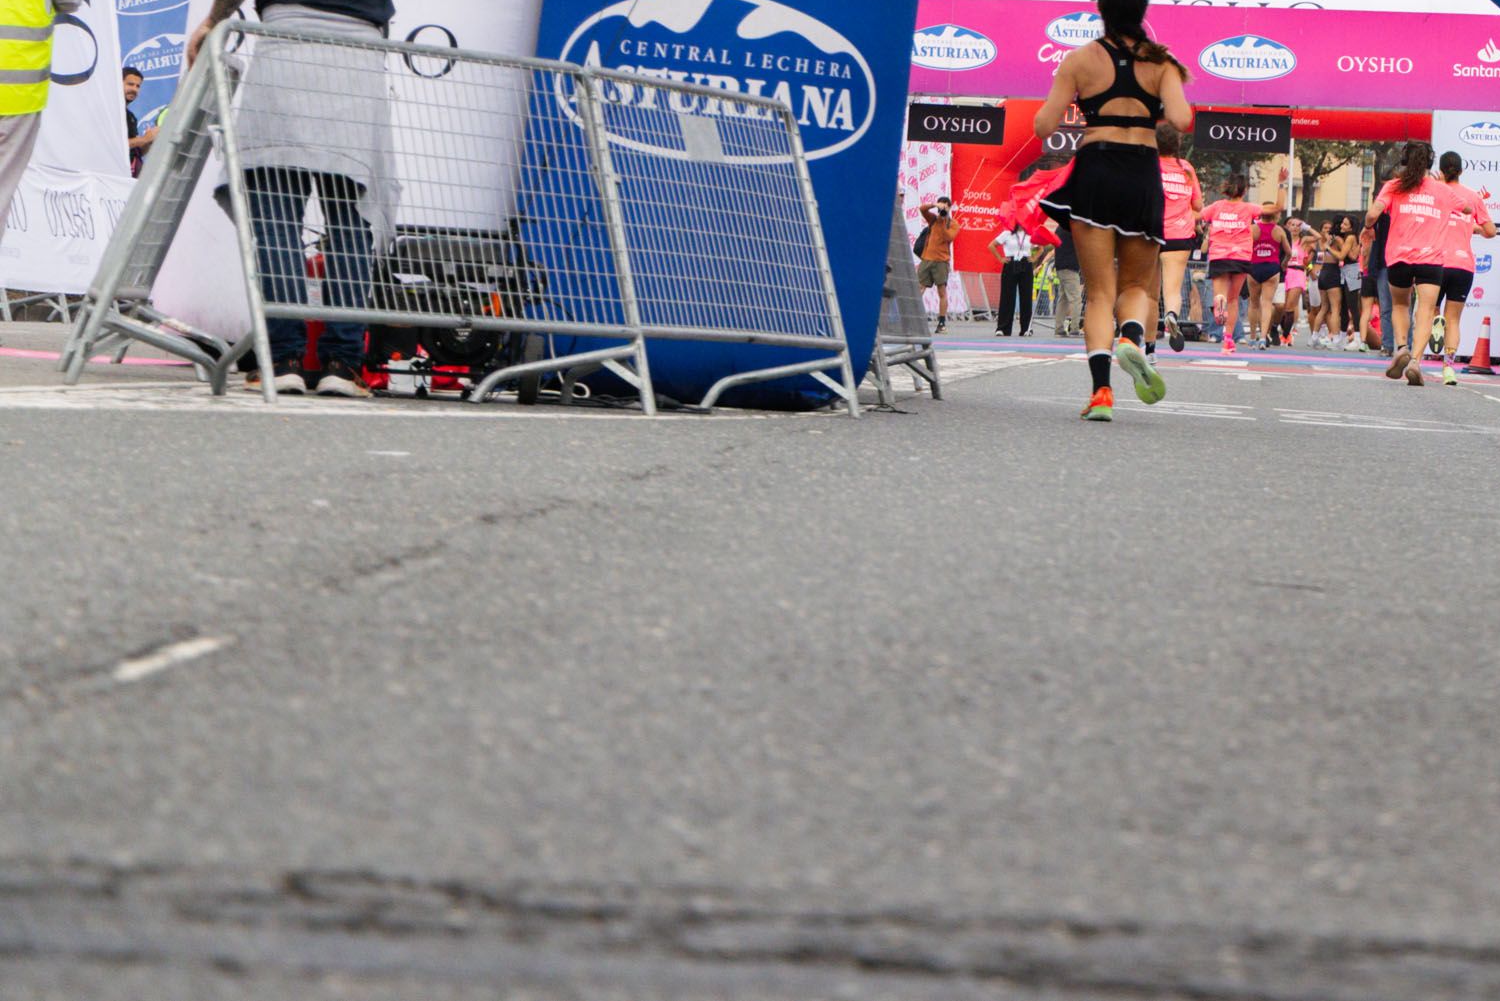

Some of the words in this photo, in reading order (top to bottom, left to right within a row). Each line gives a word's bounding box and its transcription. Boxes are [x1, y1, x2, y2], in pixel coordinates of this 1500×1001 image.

[1052, 24, 1101, 39] ASTURIA
[620, 39, 733, 65] CENTRAL
[745, 52, 852, 79] LECHERA
[1208, 51, 1288, 69] ASTURIANA
[1337, 55, 1414, 74] OYSHO
[923, 115, 992, 134] OYSHO
[1209, 124, 1277, 143] OYSHO
[963, 188, 991, 201] Sports
[958, 203, 1000, 216] Santande
